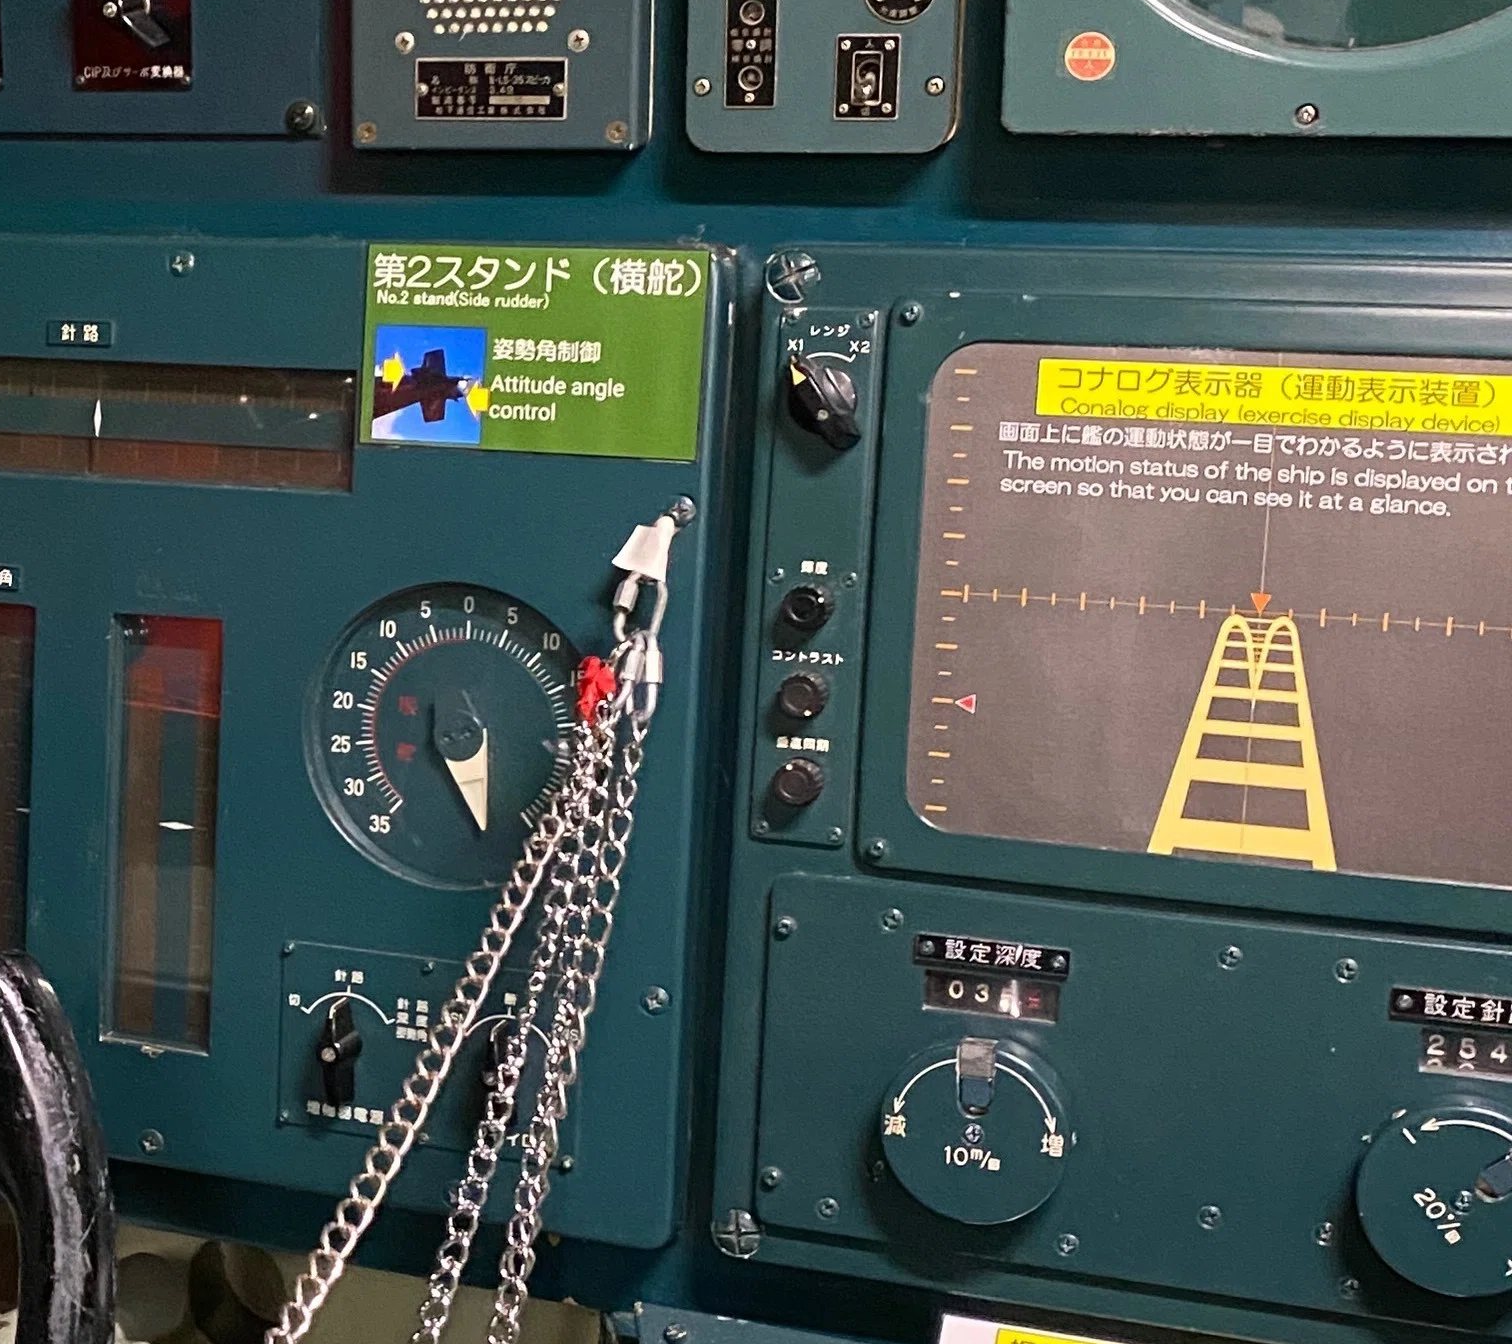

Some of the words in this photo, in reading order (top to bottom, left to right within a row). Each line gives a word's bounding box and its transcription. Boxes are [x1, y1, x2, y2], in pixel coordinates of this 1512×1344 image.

[373, 252, 702, 297] 第2スタンド（横舵）
[376, 289, 409, 305] No.2
[413, 290, 490, 308] stand(Side
[495, 293, 550, 310] rudder)
[810, 324, 850, 337] レンジ
[492, 338, 601, 364] 姿勢角制御
[490, 374, 567, 395] Attitude
[571, 379, 625, 399] angle
[1057, 367, 1496, 408] コナログ表示器（運動表示装置）
[488, 402, 556, 421] control
[1061, 397, 1148, 420] Conalog
[1155, 401, 1229, 424] display
[1238, 405, 1331, 425] (exercise
[1338, 410, 1415, 432] display
[1421, 412, 1500, 433] device)
[1003, 450, 1045, 471] The
[1050, 455, 1124, 475] motion
[1129, 459, 1198, 479] status
[1204, 461, 1229, 480] of
[1235, 463, 1272, 482] the
[1277, 465, 1325, 487] ship
[1331, 467, 1348, 486] is
[1354, 468, 1461, 493] displayed
[1467, 477, 1497, 494] on
[1000, 477, 1071, 496] screen
[1077, 482, 1103, 497] so
[1109, 480, 1154, 500] that
[1160, 487, 1200, 504] you
[1206, 490, 1247, 505] can
[1254, 493, 1292, 507] see
[1298, 490, 1313, 508] it
[1318, 492, 1343, 510] at
[1349, 496, 1364, 512] a
[1370, 494, 1451, 517] glance.
[420, 601, 431, 619] 5
[464, 596, 475, 613] 0
[507, 607, 518, 624] 5
[380, 620, 397, 638] 10
[543, 633, 561, 650] 10
[350, 652, 367, 670] 15
[771, 649, 844, 665] コントラスト
[333, 691, 353, 709] 20
[331, 735, 351, 753] 25
[344, 778, 364, 796] 30
[369, 815, 390, 834] 35
[945, 938, 1043, 970] 設定深度
[1424, 992, 1512, 1024] 設定針
[1427, 1034, 1507, 1064] 254
[884, 1114, 907, 1138] 減
[1041, 1133, 1064, 1157] 増
